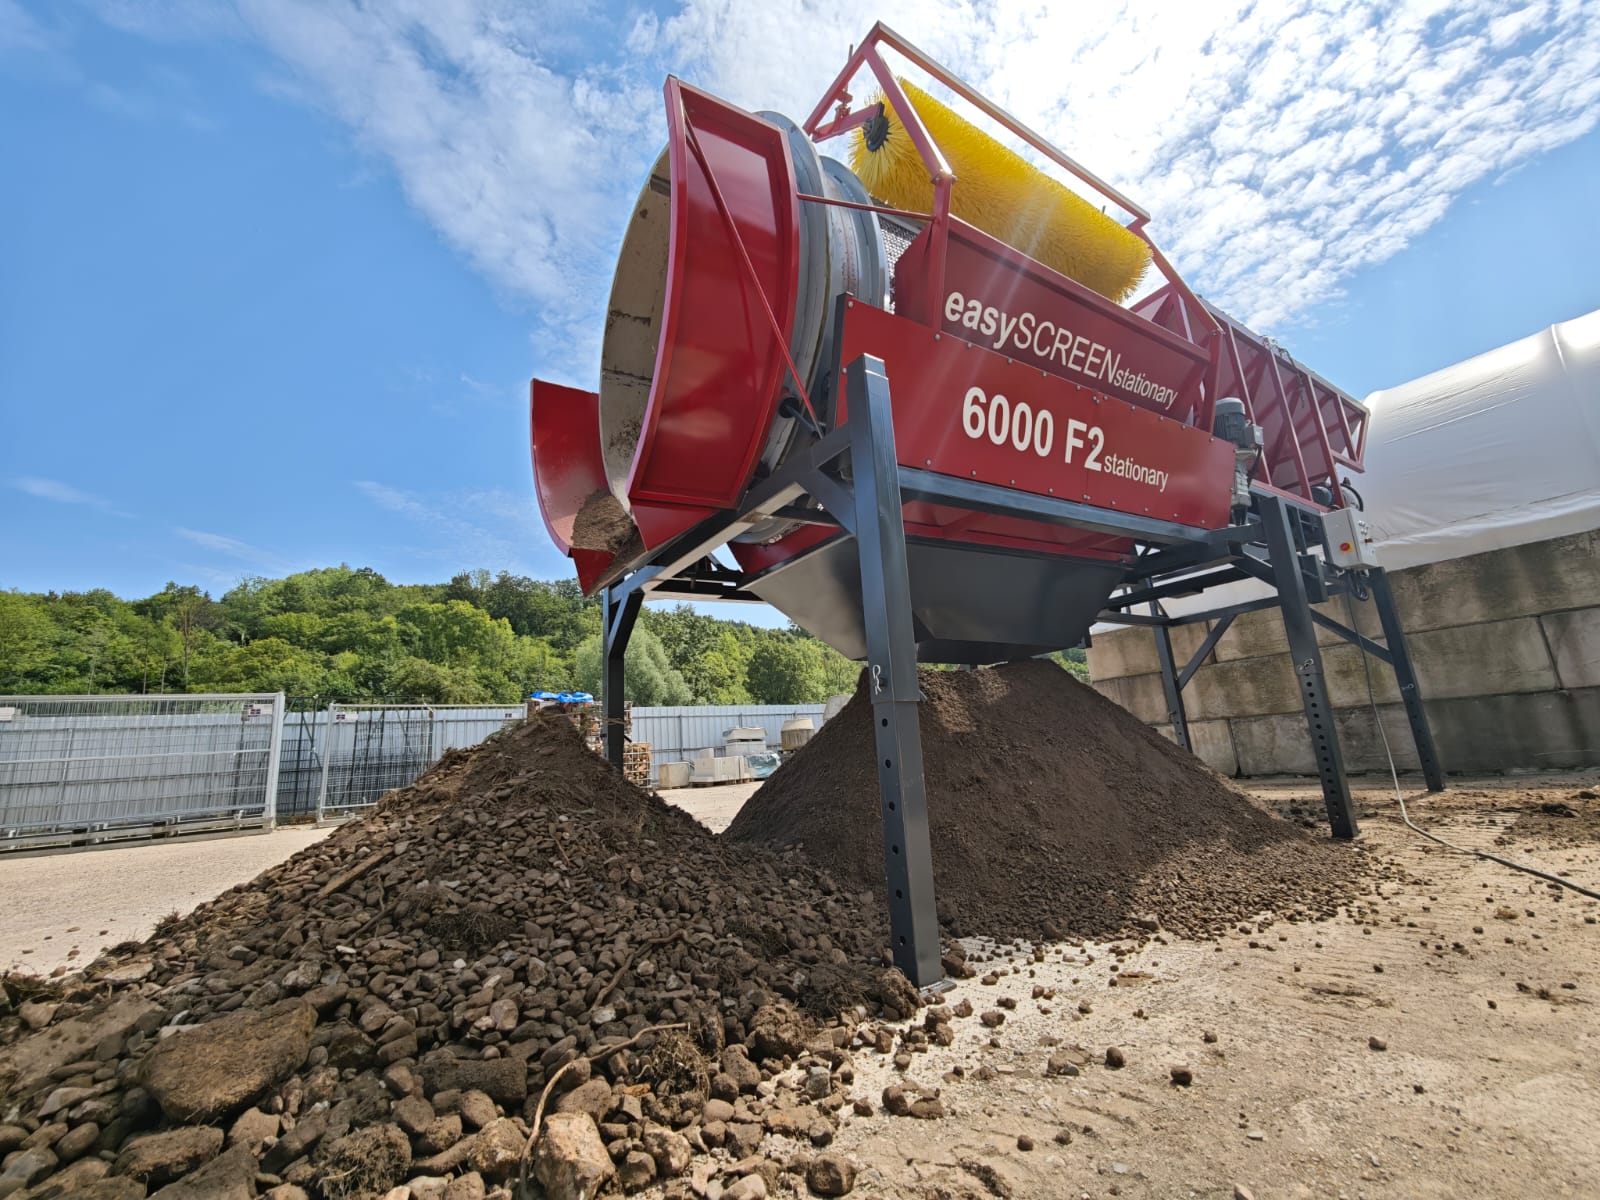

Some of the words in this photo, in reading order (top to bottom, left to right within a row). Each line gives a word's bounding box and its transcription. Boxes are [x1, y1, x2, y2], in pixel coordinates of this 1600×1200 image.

[962, 386, 1054, 457] 6000
[1064, 418, 1105, 472] F2
[1103, 453, 1169, 493] stationary
